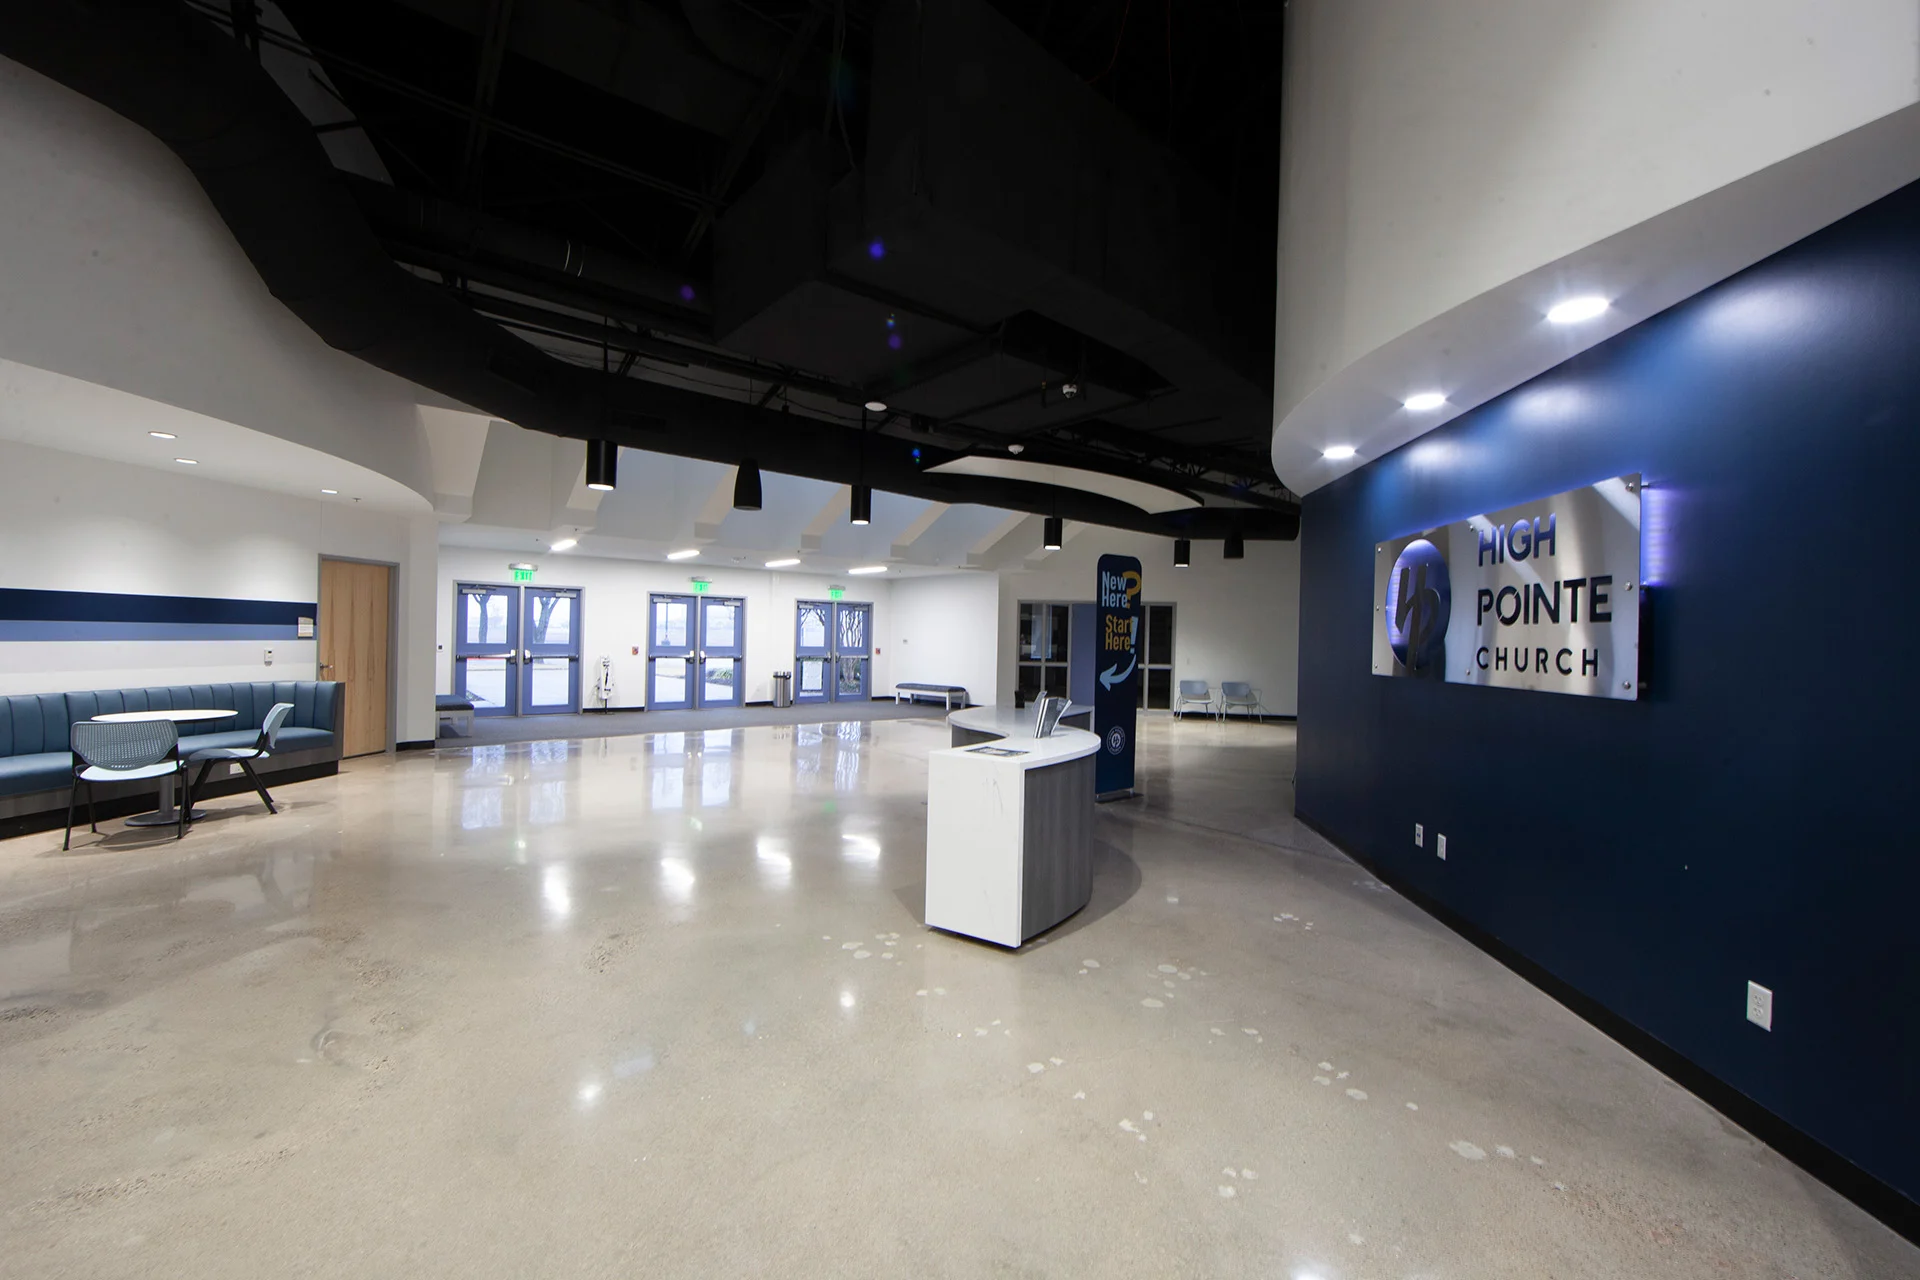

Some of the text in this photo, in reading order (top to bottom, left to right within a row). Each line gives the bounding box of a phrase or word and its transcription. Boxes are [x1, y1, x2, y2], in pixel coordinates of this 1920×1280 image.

[1478, 512, 1556, 567] HIGH
[1102, 571, 1127, 591] New
[1476, 575, 1613, 627] POINTE
[1475, 646, 1599, 678] CHURCH
